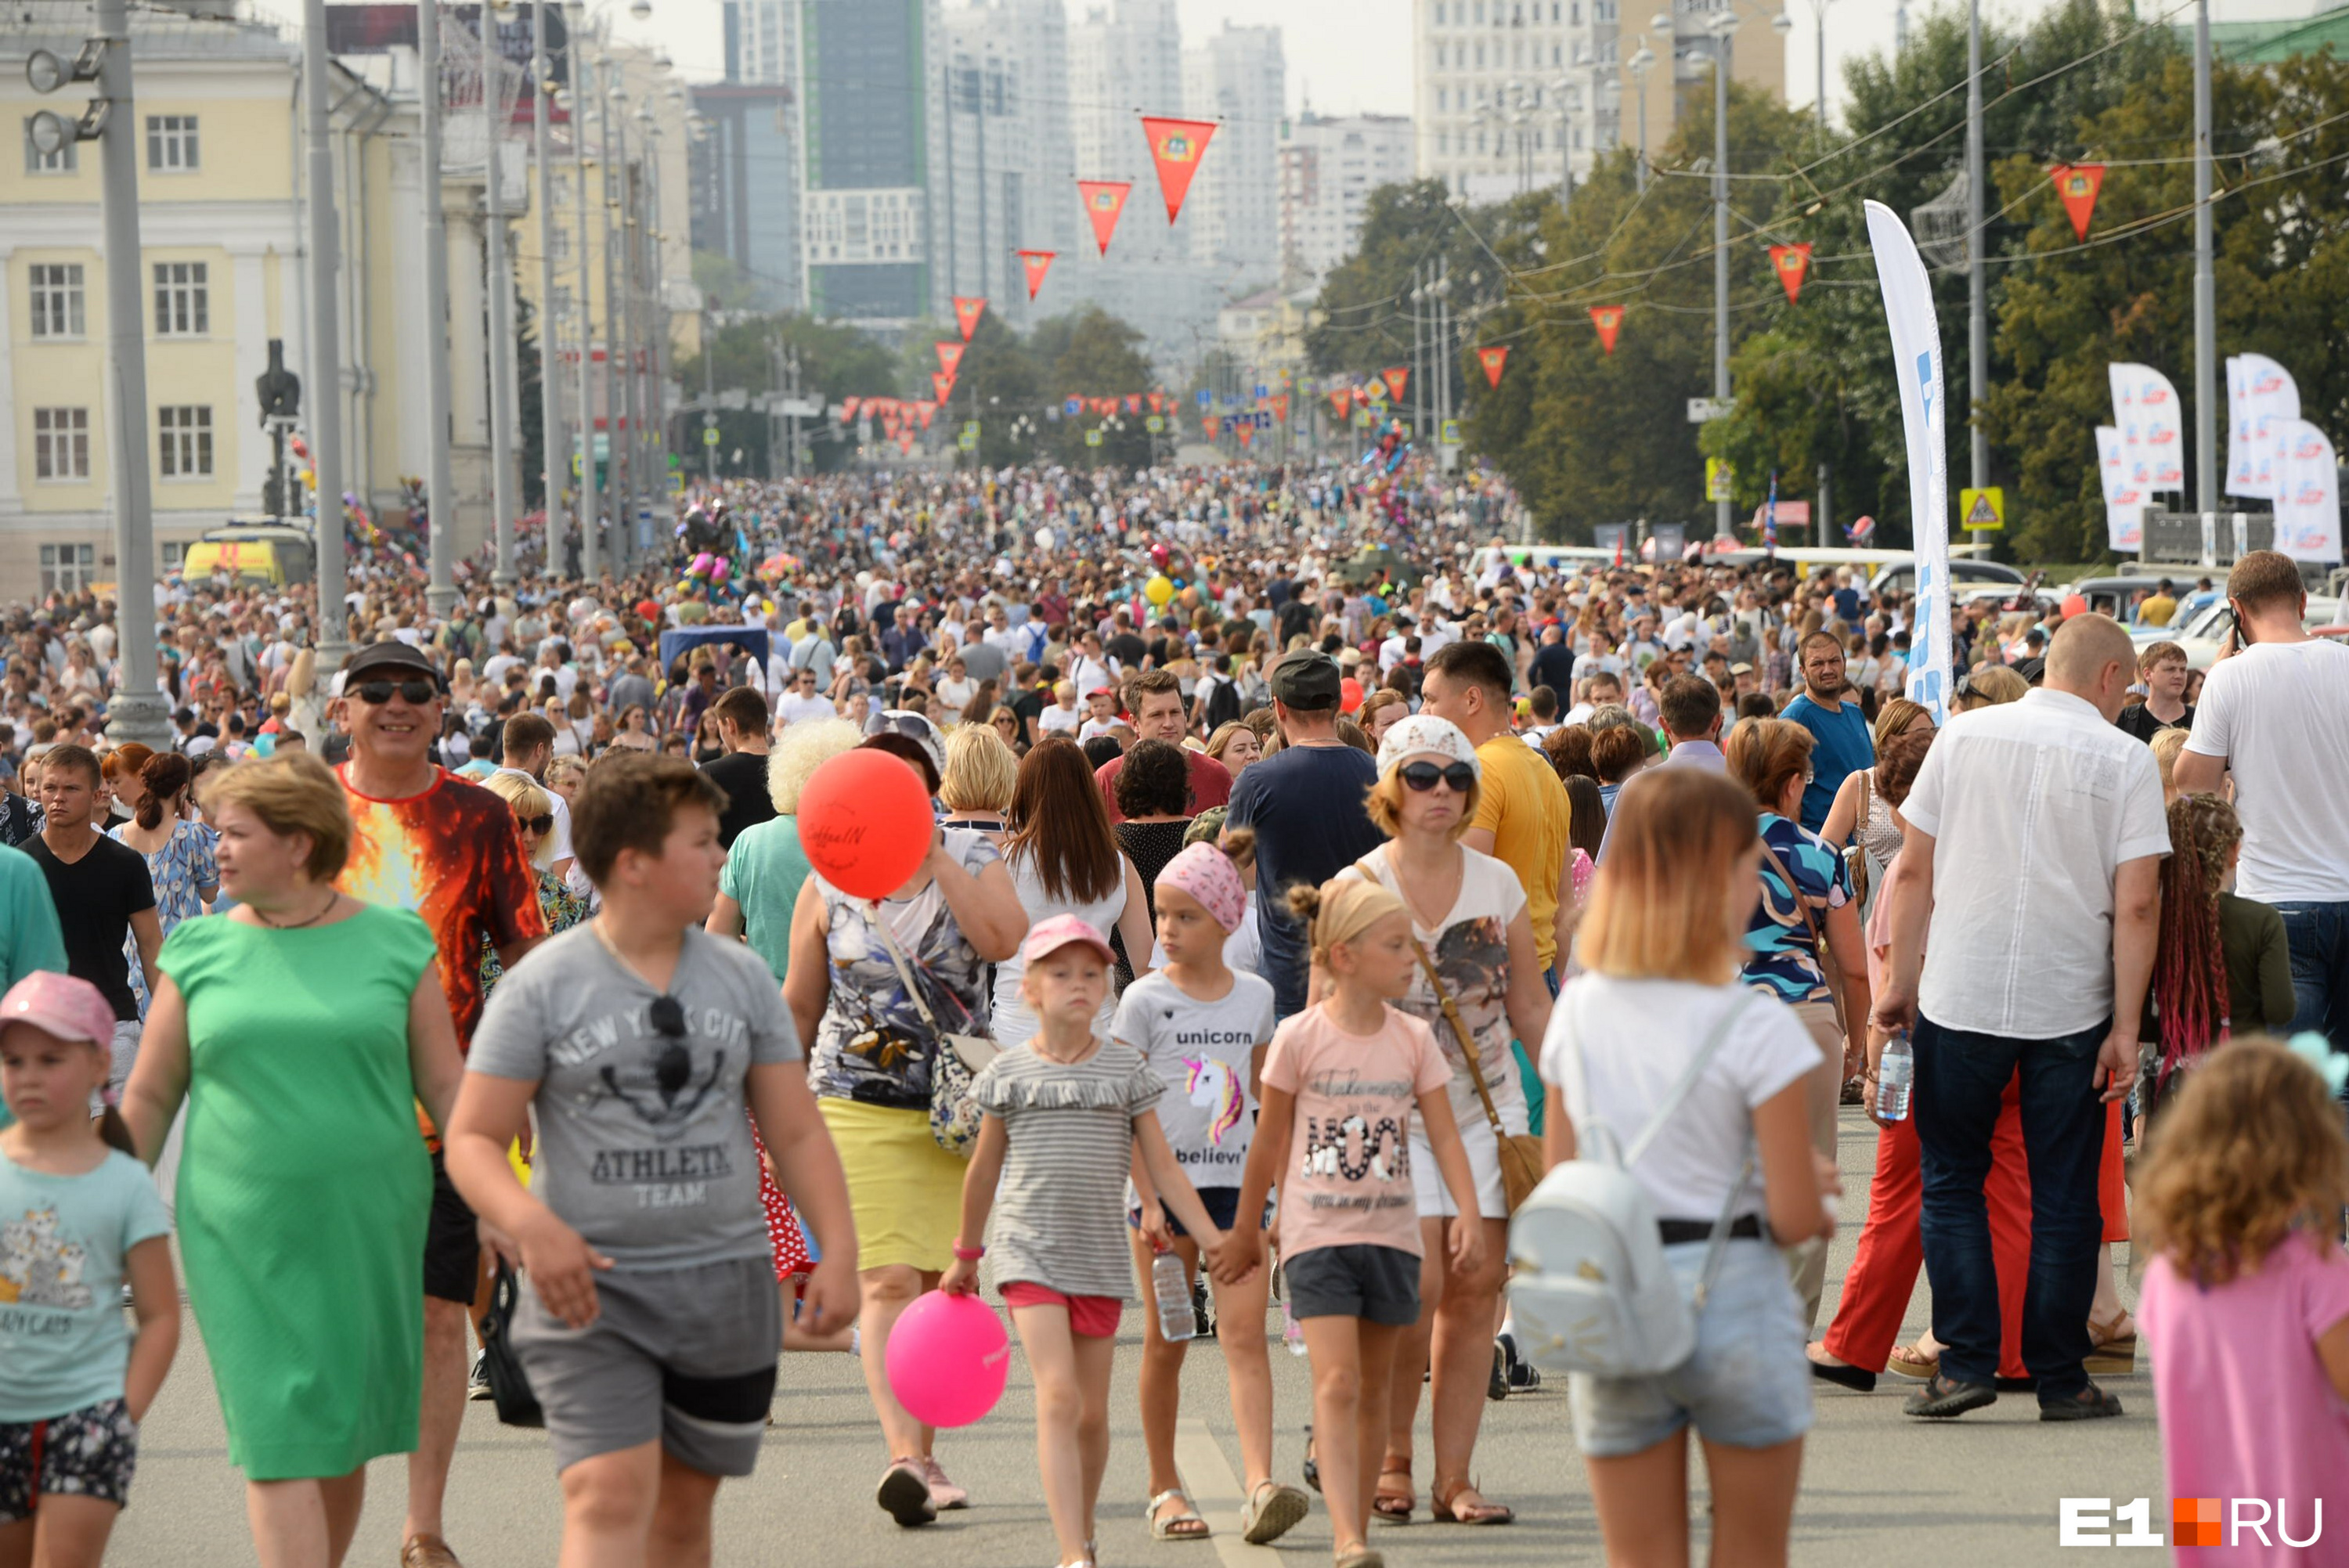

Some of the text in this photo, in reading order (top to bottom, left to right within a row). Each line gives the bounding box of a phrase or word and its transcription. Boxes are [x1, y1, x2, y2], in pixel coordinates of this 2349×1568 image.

[548, 1015, 619, 1067] NEW
[1176, 1029, 1253, 1045] unicorn
[1175, 1148, 1242, 1165] believ
[633, 1183, 707, 1206] TEAM
